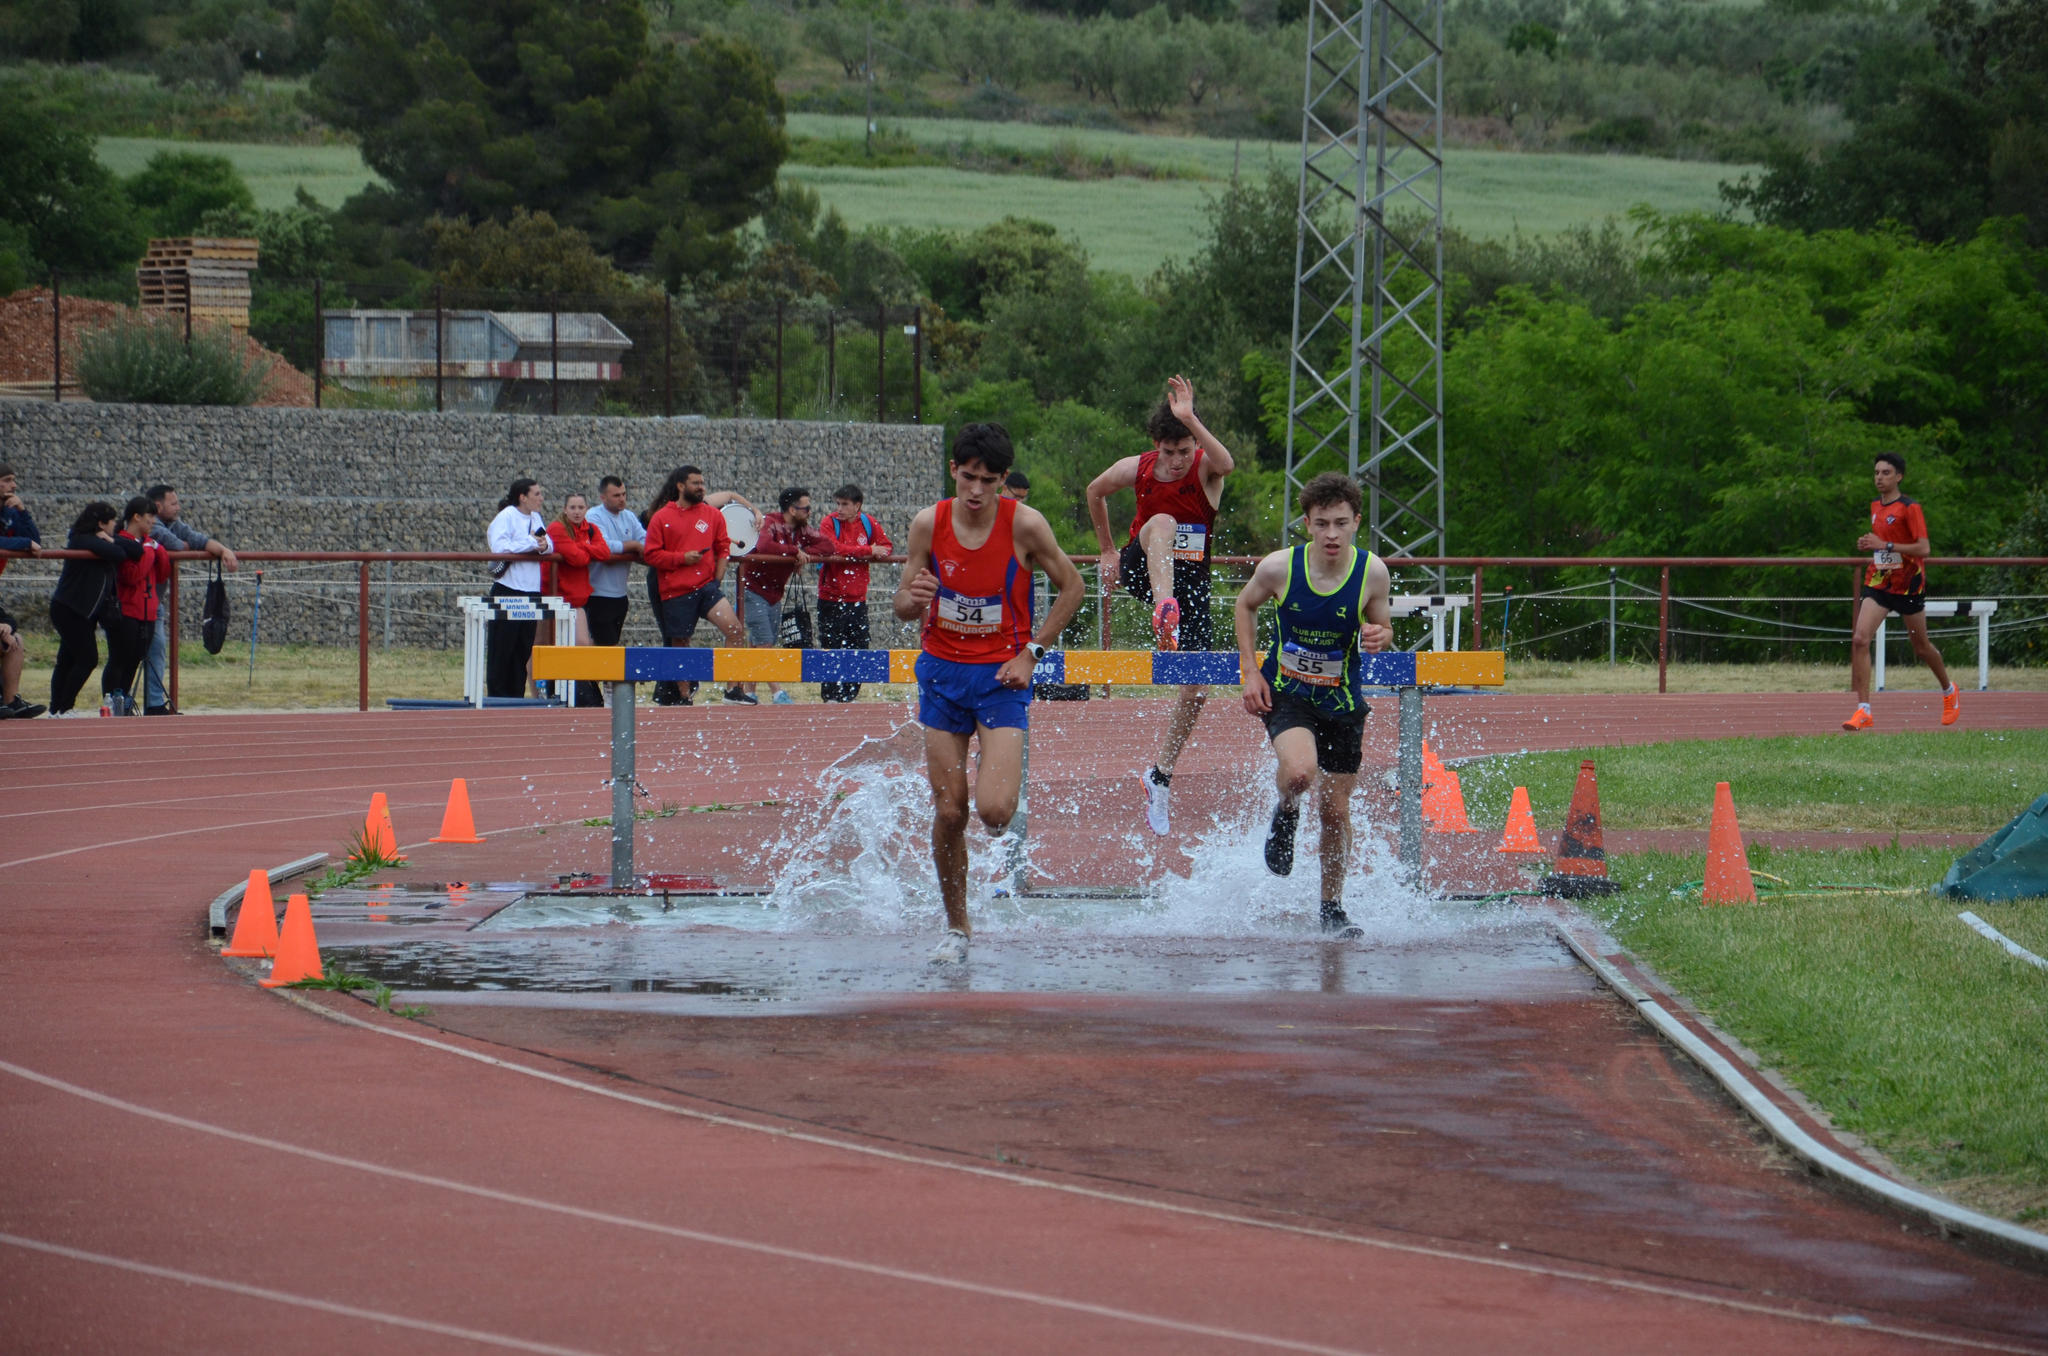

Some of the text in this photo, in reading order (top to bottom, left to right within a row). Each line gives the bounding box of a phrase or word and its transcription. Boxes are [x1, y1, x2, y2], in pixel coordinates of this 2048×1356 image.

[1176, 524, 1194, 532] ma
[1881, 553, 1893, 563] 66
[953, 594, 987, 605] Joma
[512, 611, 536, 619] MONDO
[957, 606, 983, 624] 54
[1295, 648, 1328, 659] Joma
[1297, 657, 1324, 674] 55
